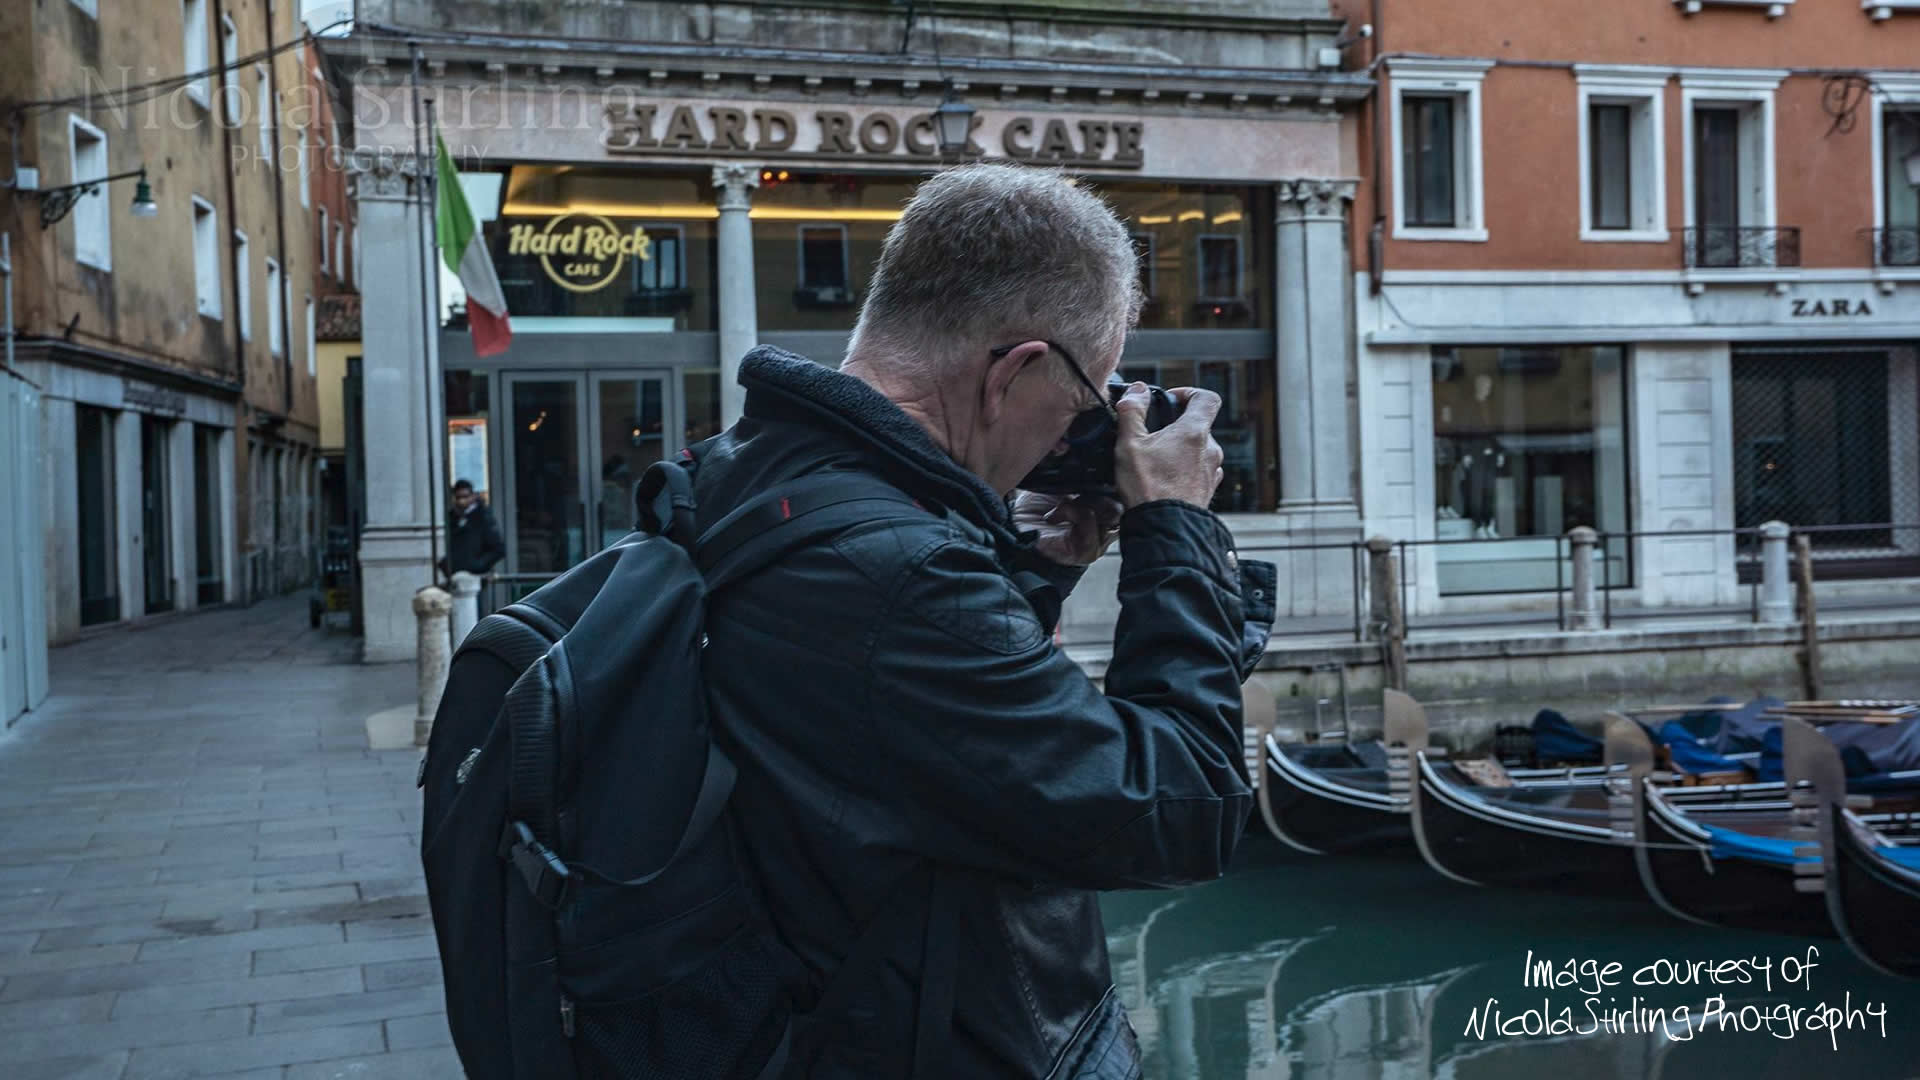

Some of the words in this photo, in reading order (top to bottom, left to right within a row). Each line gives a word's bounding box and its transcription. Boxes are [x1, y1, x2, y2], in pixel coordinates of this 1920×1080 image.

[607, 104, 798, 152] HARD
[1002, 116, 1145, 161] CAFE
[508, 224, 582, 255] Hard
[583, 225, 650, 261] Rock
[564, 263, 601, 276] CAFE
[1792, 299, 1873, 317] ZARA
